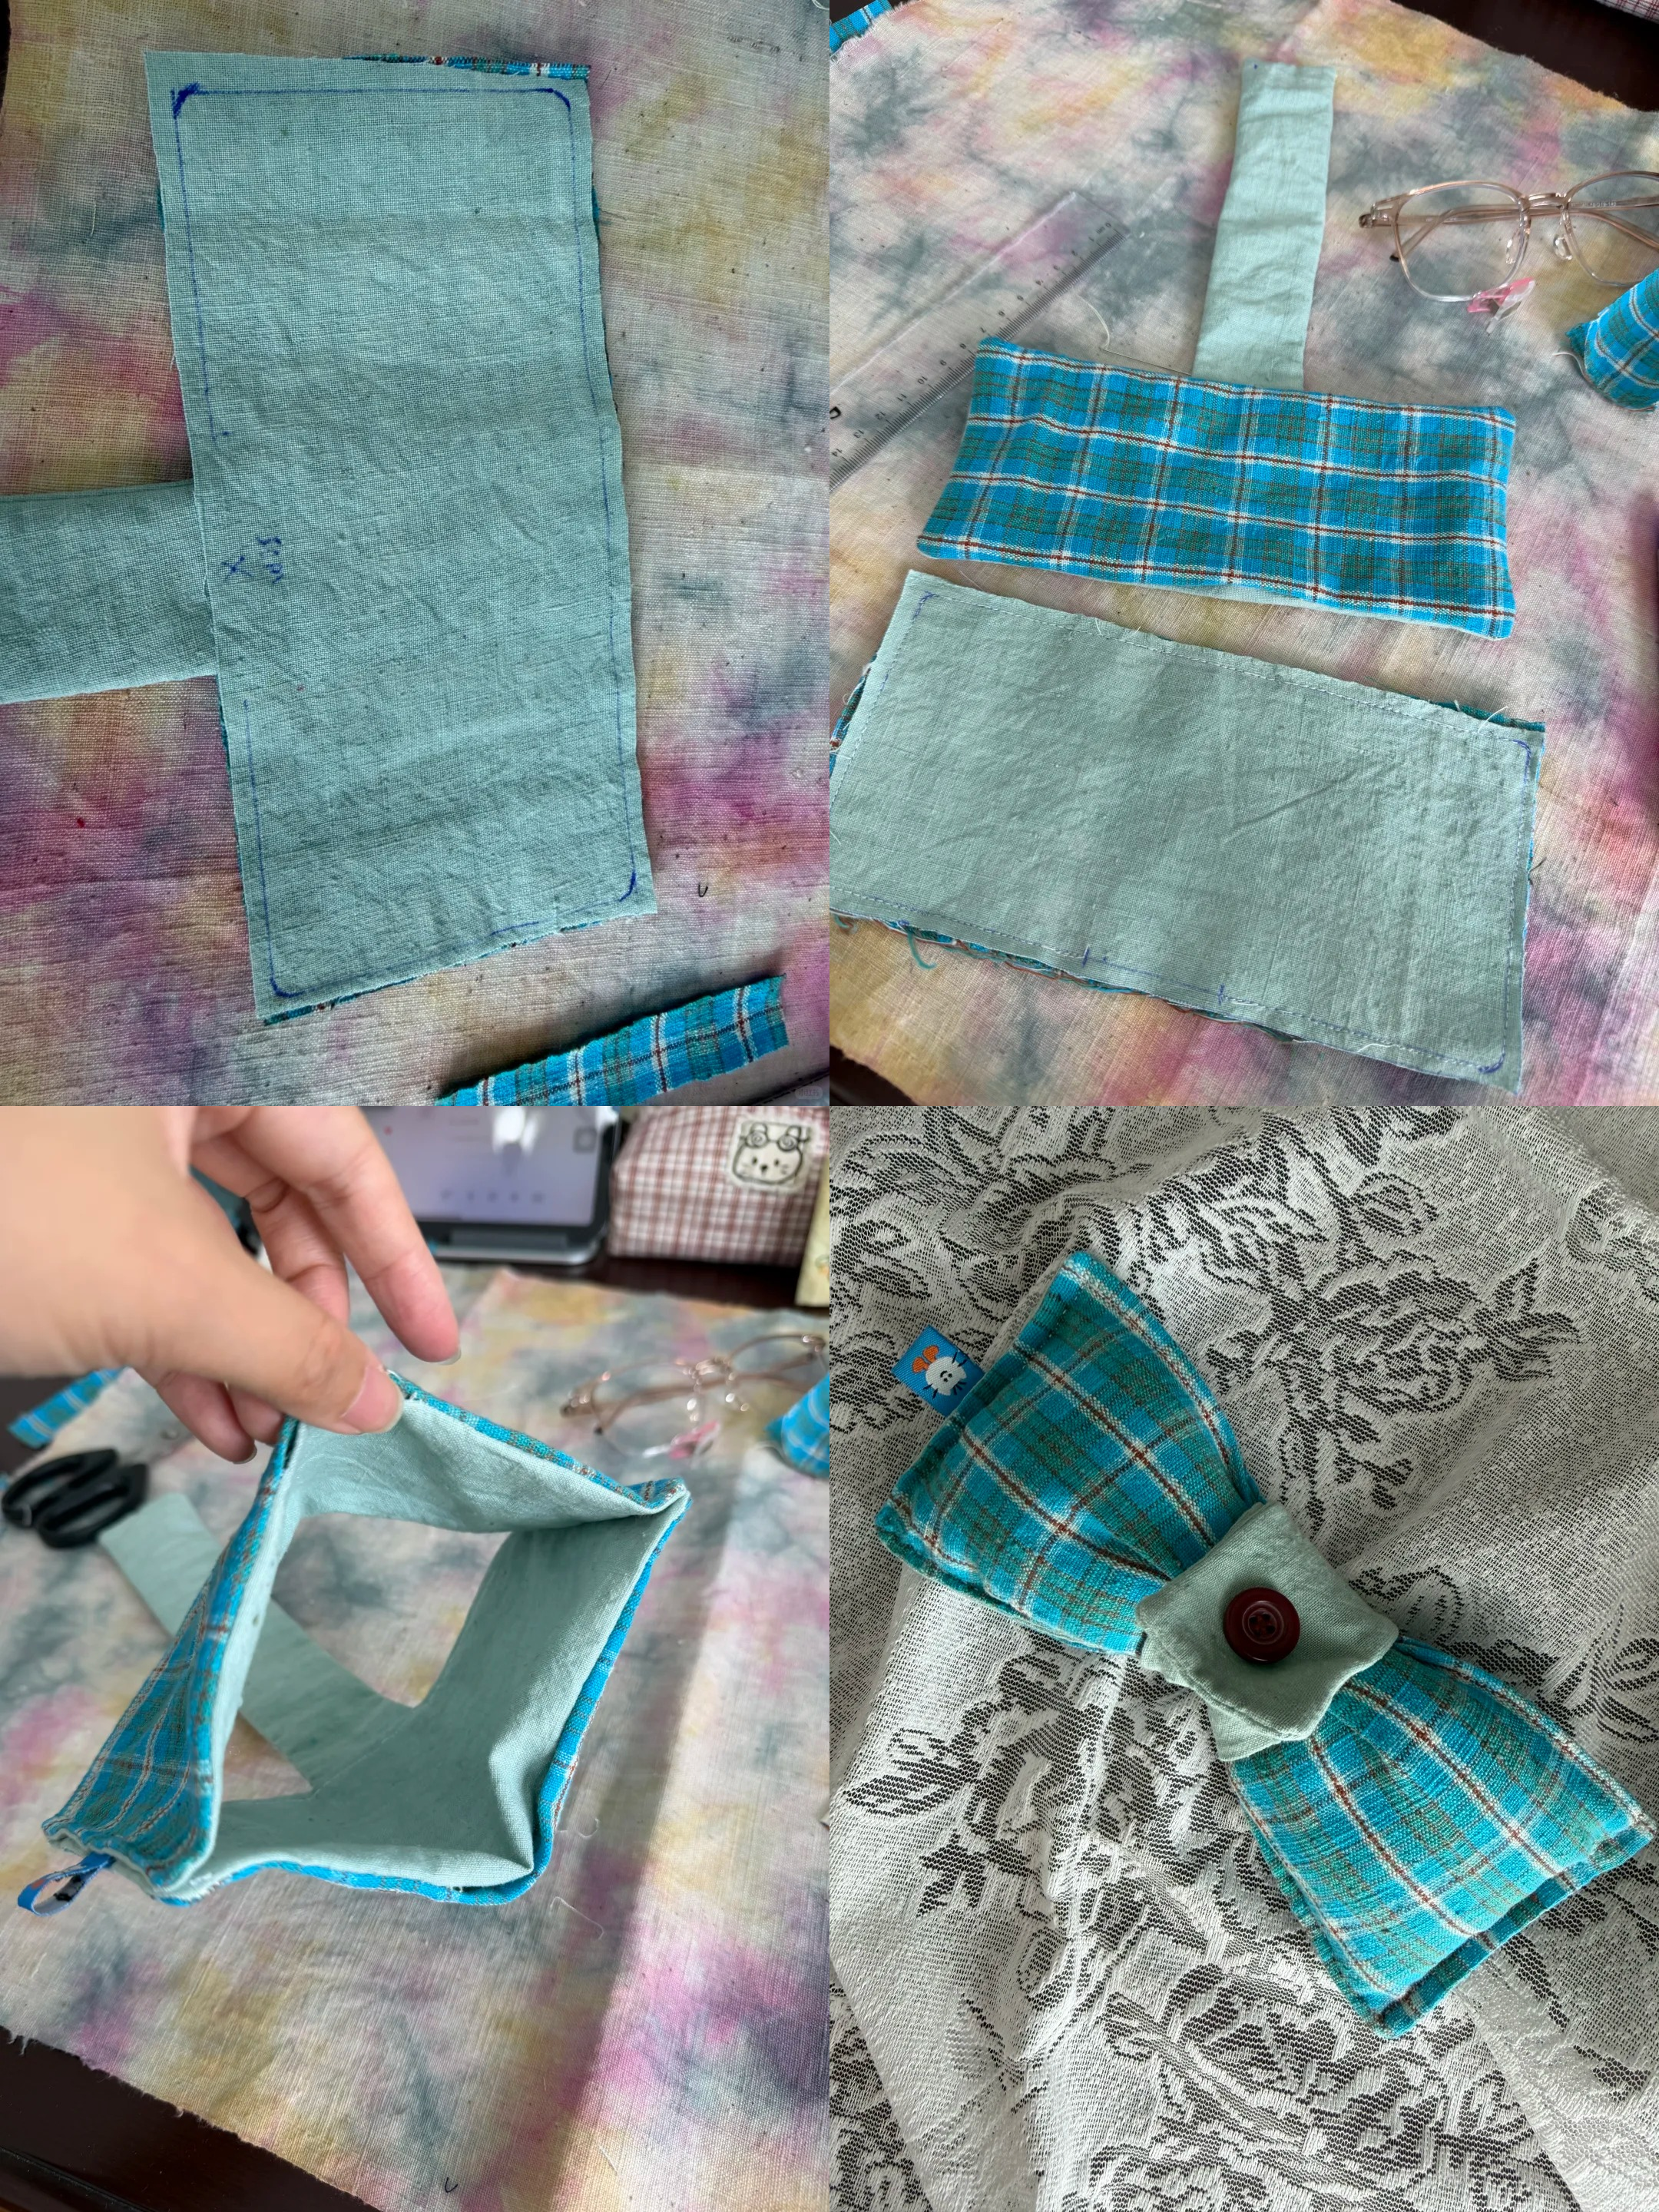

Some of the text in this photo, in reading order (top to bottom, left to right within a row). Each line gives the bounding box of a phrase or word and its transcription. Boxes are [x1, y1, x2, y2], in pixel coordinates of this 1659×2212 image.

[917, 376, 928, 385] 10
[896, 393, 907, 402] 11
[874, 411, 886, 420] 12
[853, 429, 864, 439] 13
[831, 448, 843, 457] 14
